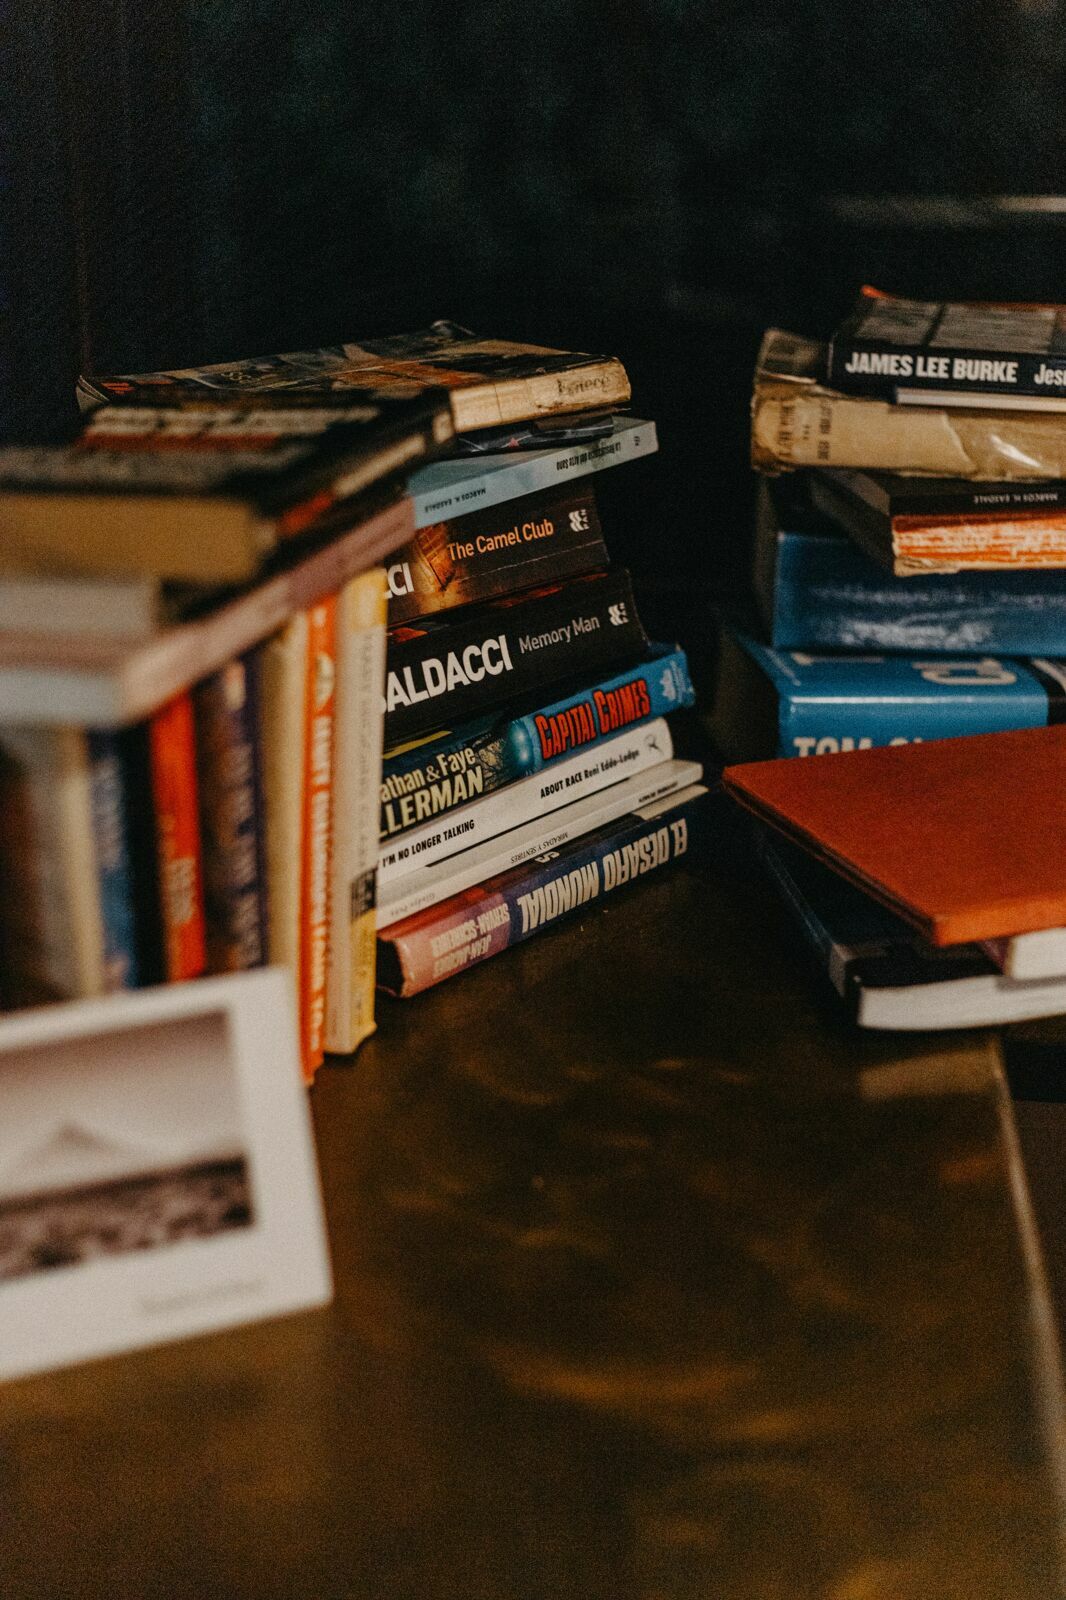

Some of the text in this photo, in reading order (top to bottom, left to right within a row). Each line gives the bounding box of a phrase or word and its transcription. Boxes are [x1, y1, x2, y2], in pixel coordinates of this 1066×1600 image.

[846, 352, 913, 376] JAMES
[916, 355, 949, 378] LEE
[953, 358, 1018, 383] BURKE
[462, 488, 486, 502] MARCOS
[447, 519, 554, 561] The Camel Club
[519, 614, 600, 654] Memory Man
[380, 634, 513, 712] ALDACCI
[535, 679, 650, 761] CAPITAL CRIMES
[380, 769, 425, 803] athan
[439, 747, 476, 775] Faye
[540, 749, 640, 798] ABOUT RACE Reni Eddo-Lodge
[380, 766, 485, 836] LERMAN
[382, 820, 475, 868] I'M NO LONGER TALKING
[542, 832, 568, 849] MIRADAS
[517, 817, 688, 934] EL DESAFIO MUNDIAL
